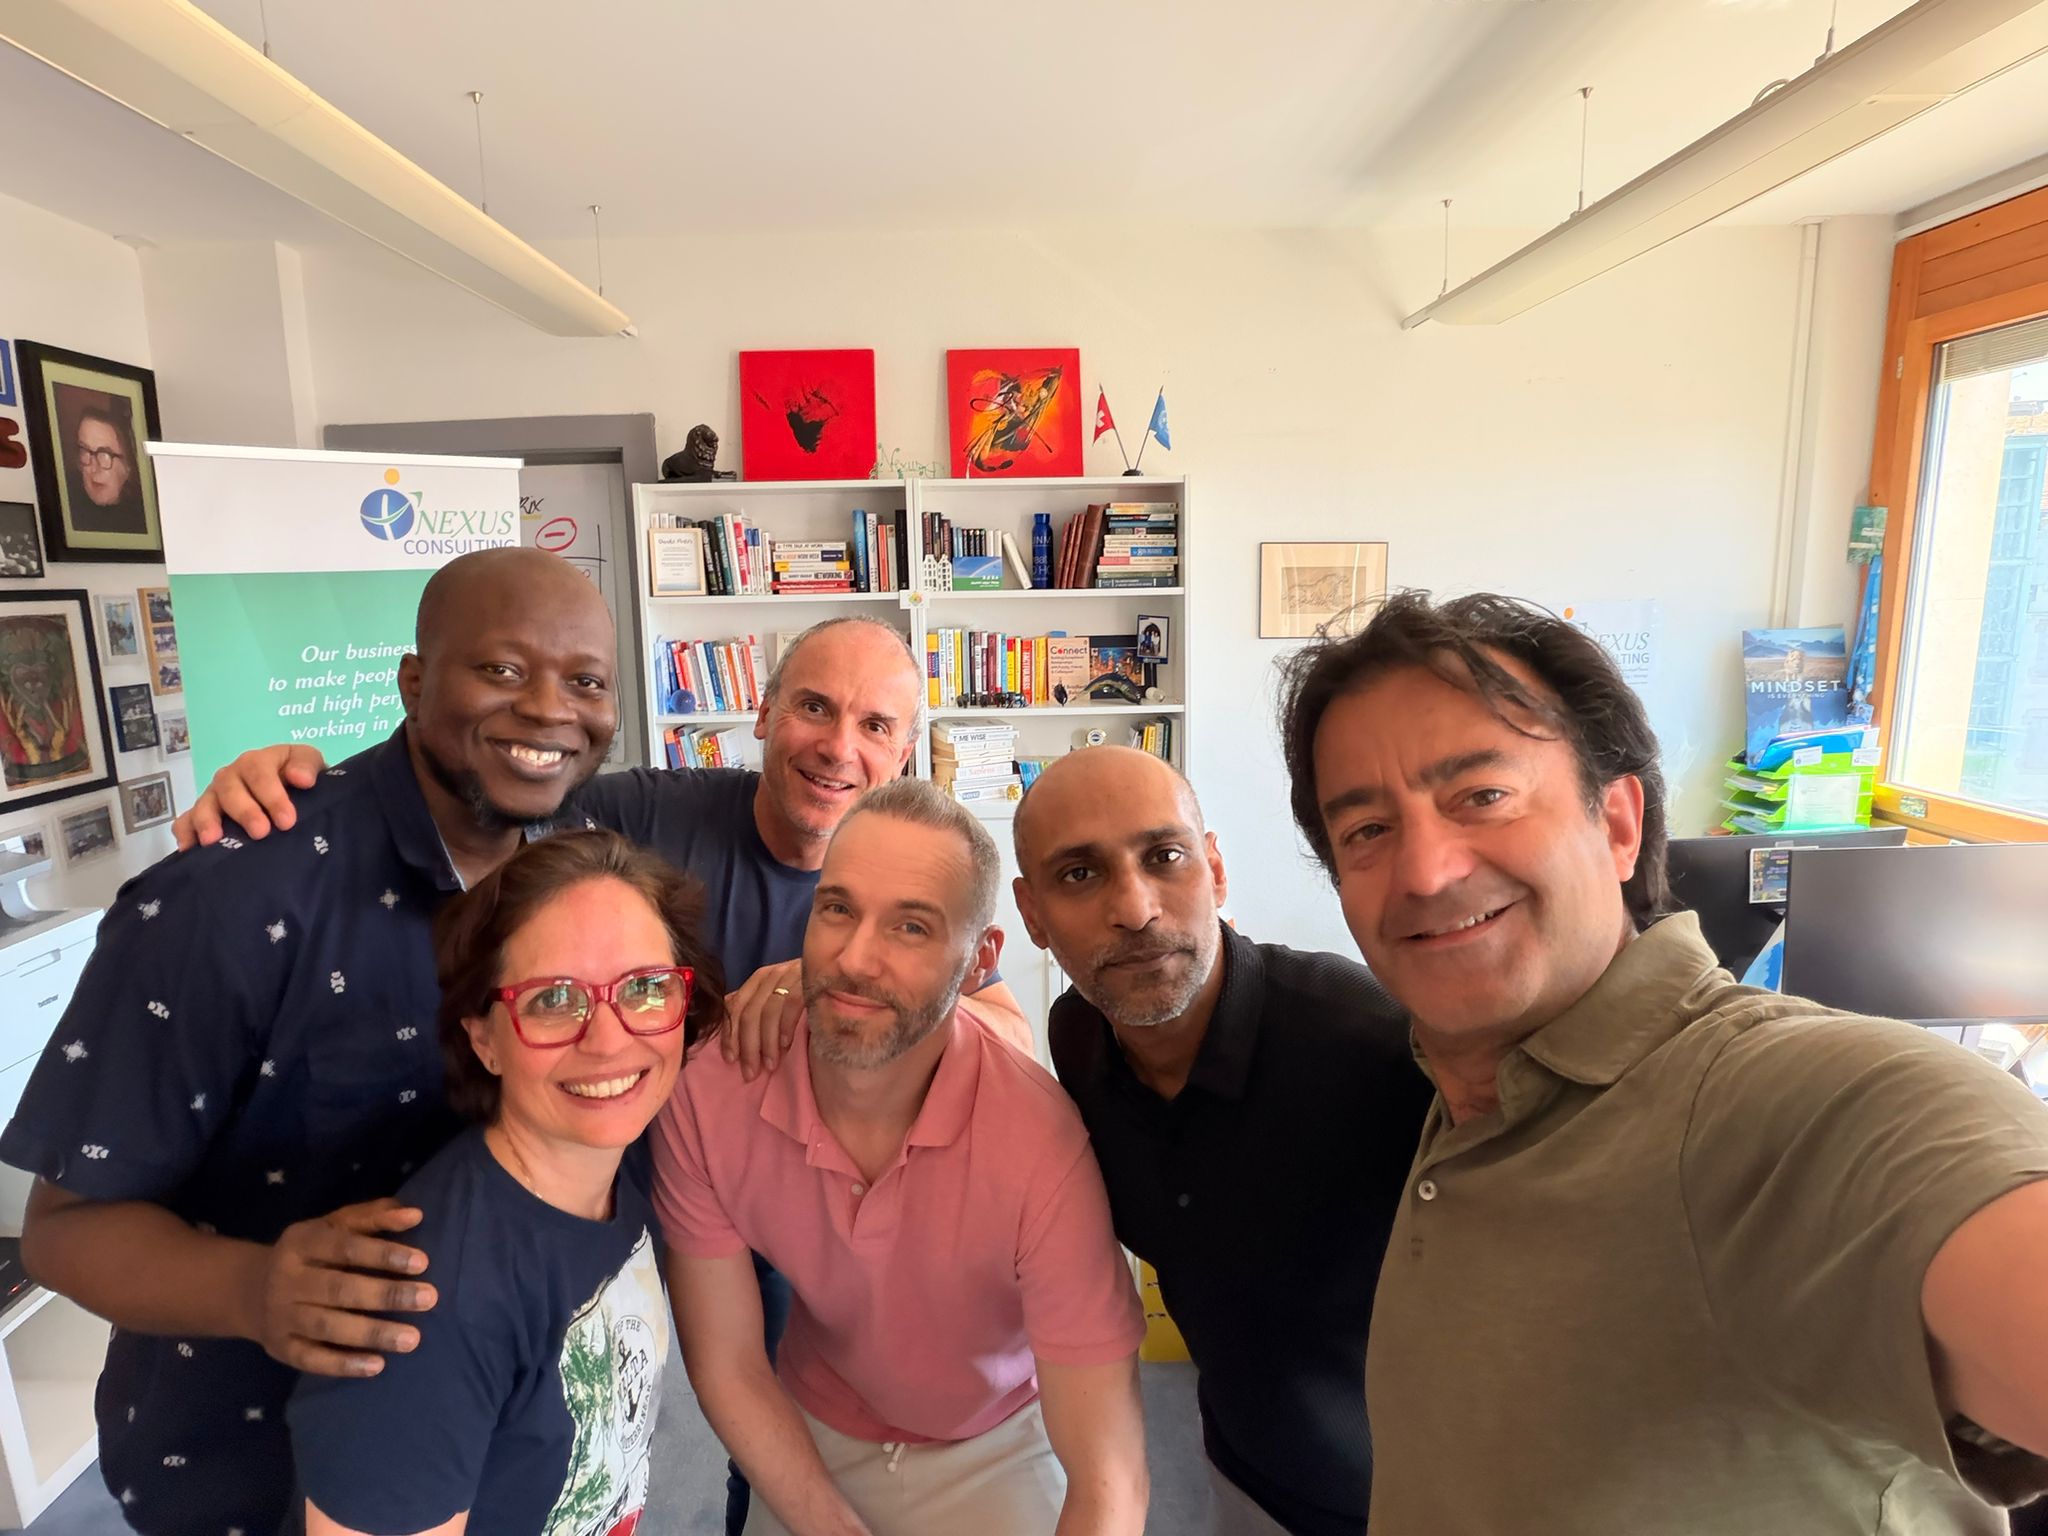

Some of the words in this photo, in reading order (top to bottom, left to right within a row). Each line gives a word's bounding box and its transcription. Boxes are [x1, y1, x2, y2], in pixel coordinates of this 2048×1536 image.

[415, 510, 515, 538] NEXUS
[301, 645, 339, 663] Our
[346, 641, 418, 660] business
[1050, 645, 1088, 655] Connect
[1595, 632, 1650, 651] EXUS
[1615, 652, 1650, 664] LTING
[268, 677, 288, 692] to
[295, 670, 347, 690] make
[352, 667, 398, 690] peop
[1750, 680, 1841, 693] MINDSET
[278, 696, 317, 717] and
[322, 692, 363, 716] high
[290, 720, 366, 740] working
[373, 715, 388, 731] in
